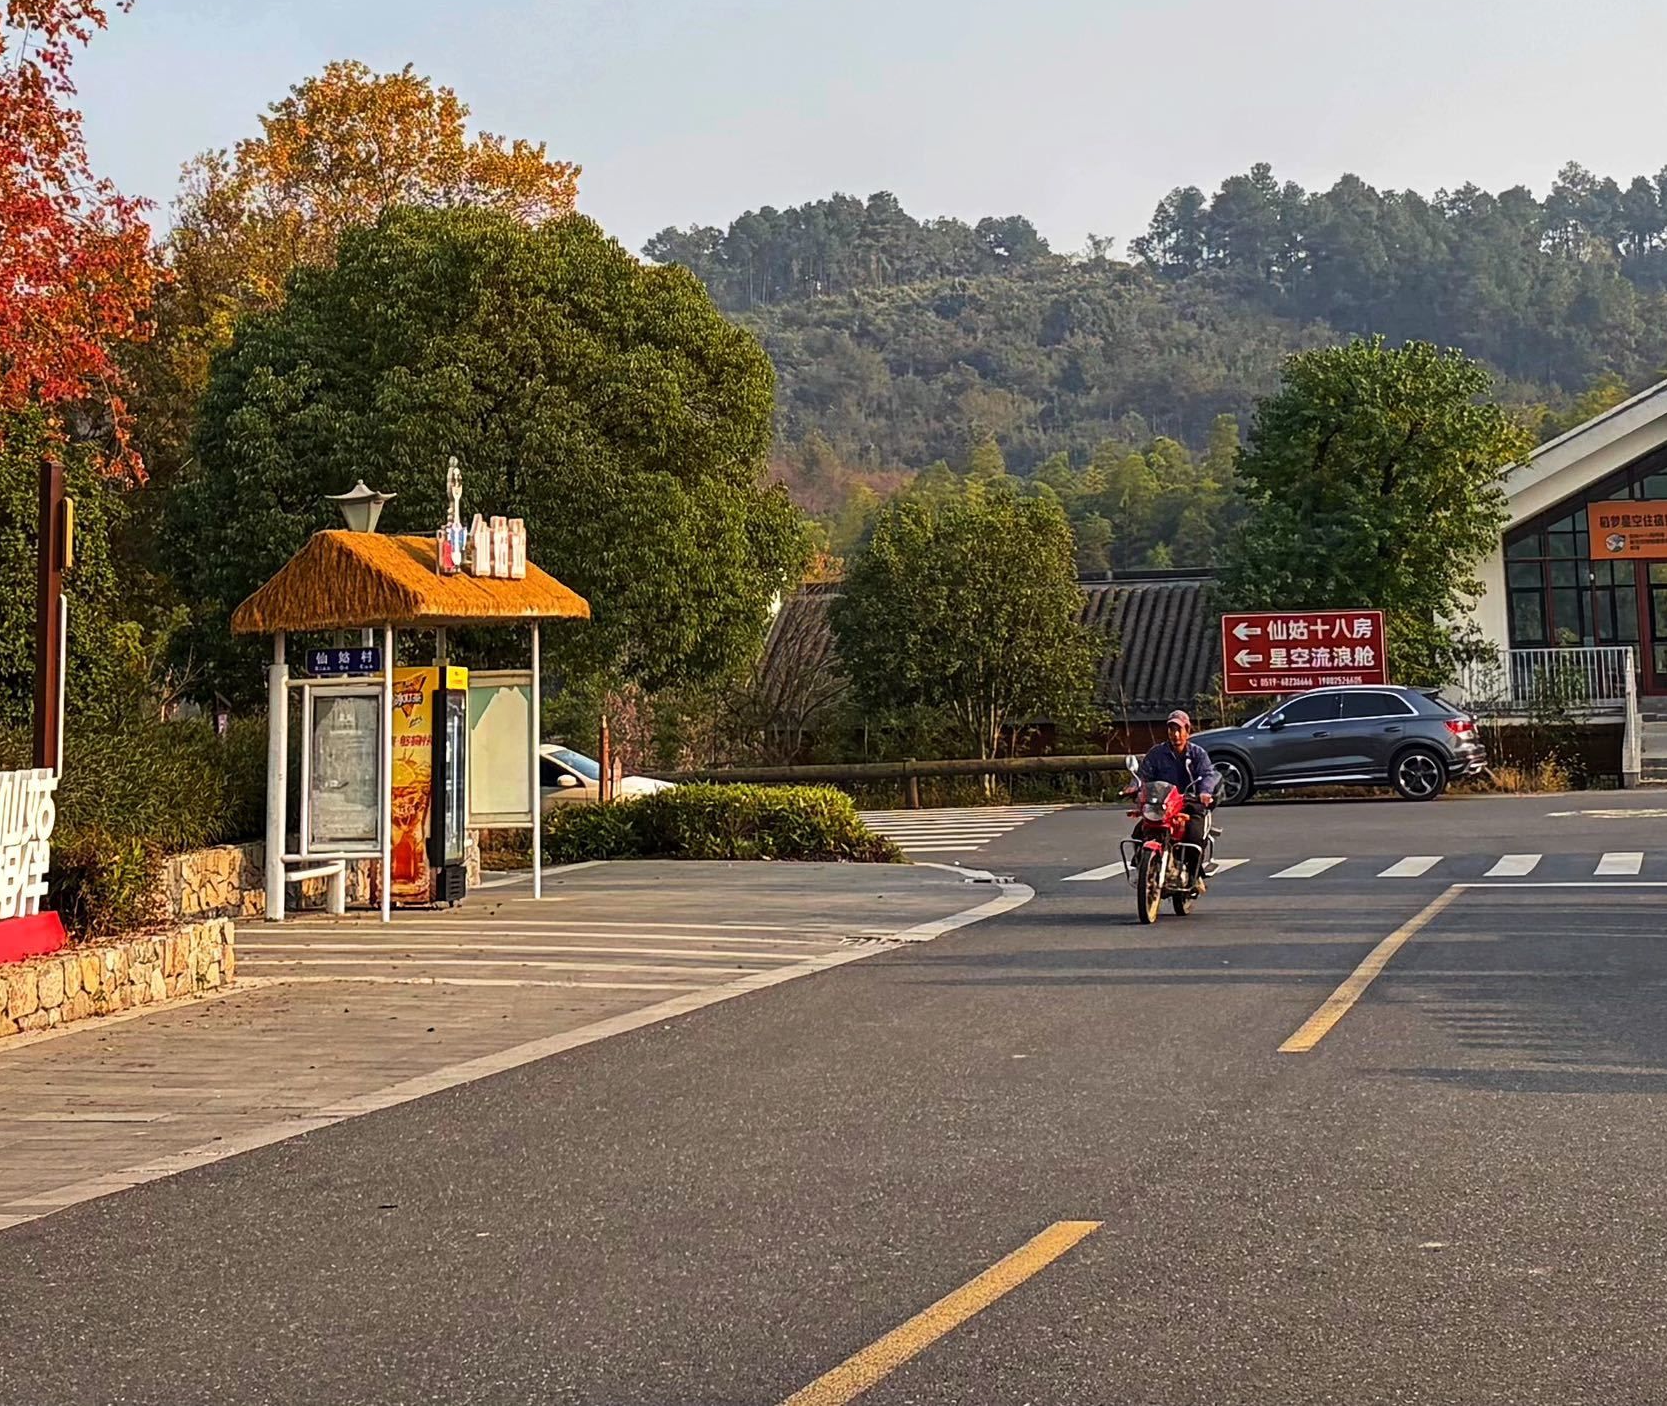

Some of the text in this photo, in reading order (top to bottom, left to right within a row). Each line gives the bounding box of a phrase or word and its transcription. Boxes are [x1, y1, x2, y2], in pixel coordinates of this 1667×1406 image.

[1266, 618, 1373, 641] 仙姑十八房
[1269, 645, 1375, 669] 星空流浪舱
